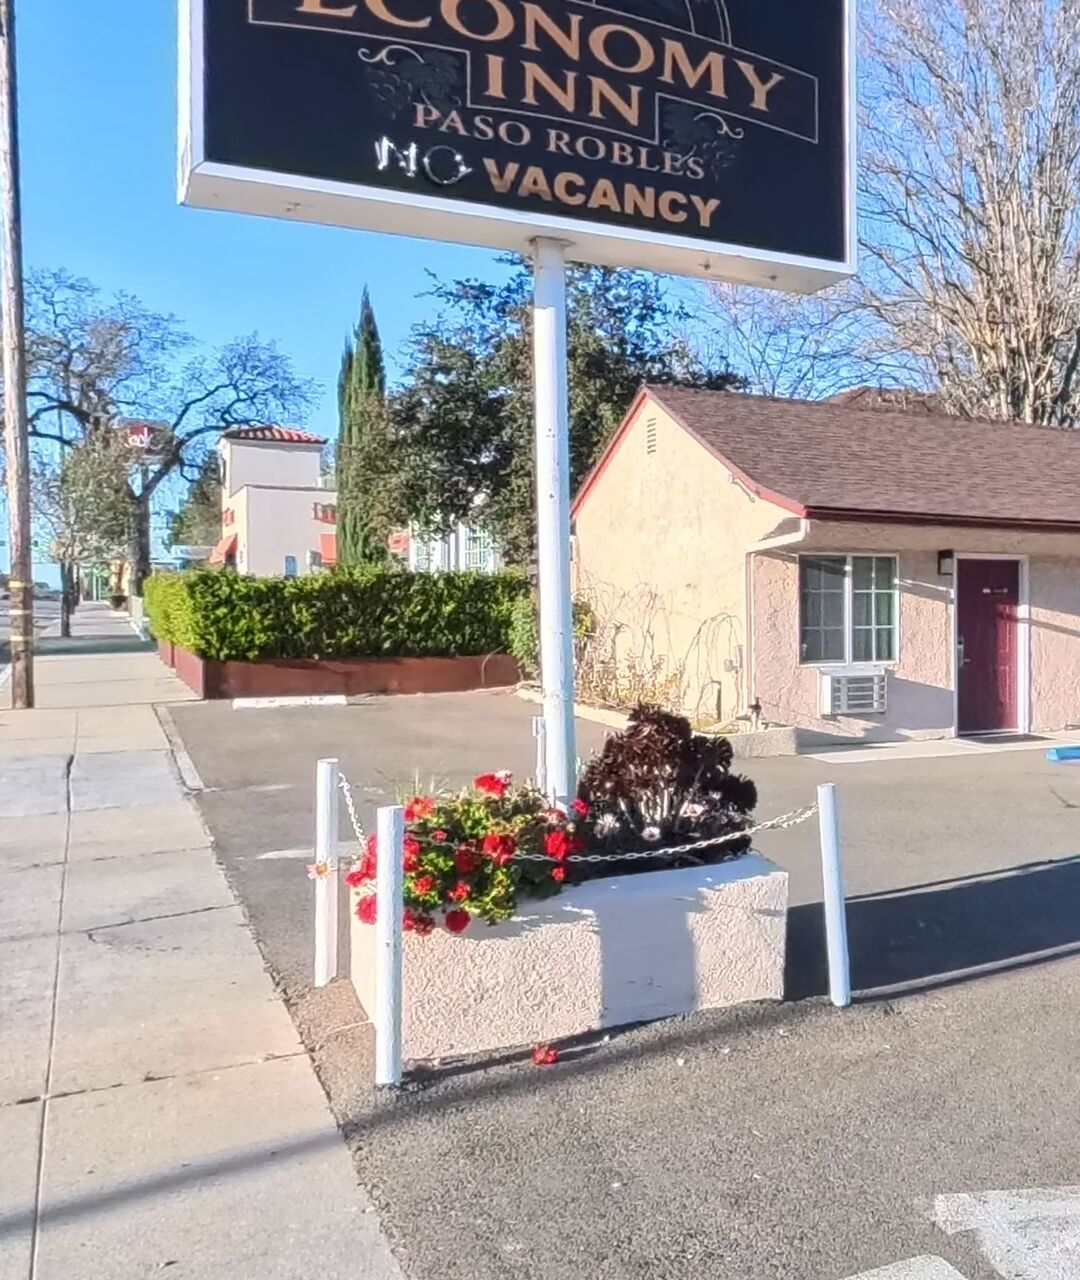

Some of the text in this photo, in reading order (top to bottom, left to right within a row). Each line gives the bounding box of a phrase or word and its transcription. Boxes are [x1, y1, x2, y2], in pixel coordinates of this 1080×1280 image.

[484, 55, 642, 127] INN
[412, 102, 705, 180] PASO ROBLES
[375, 136, 721, 228] NO VACANCY
